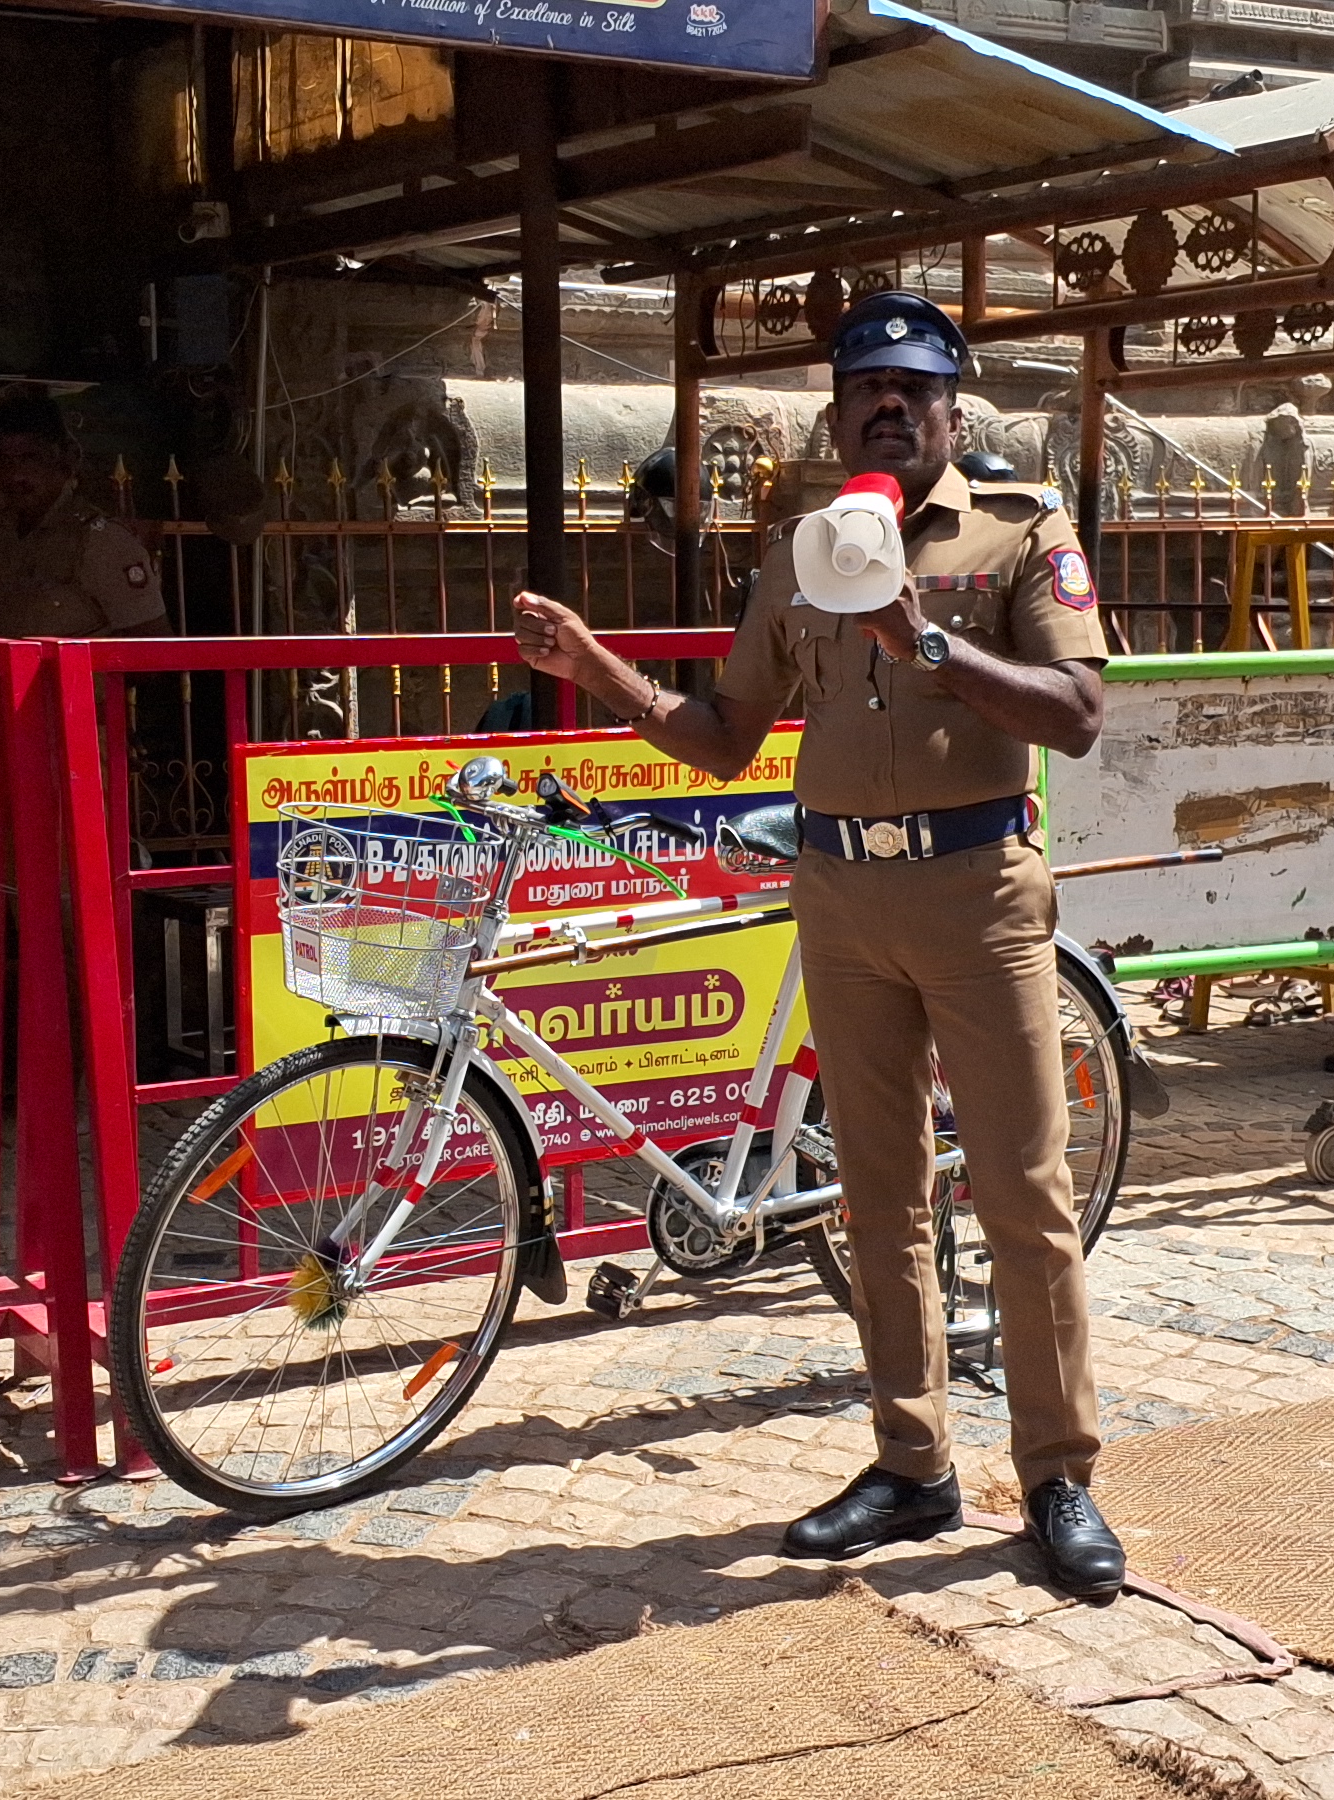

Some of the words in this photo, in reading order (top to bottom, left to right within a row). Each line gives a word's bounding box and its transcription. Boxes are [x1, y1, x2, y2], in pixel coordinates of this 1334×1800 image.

[474, 2, 491, 25] of
[496, 1, 573, 26] Excellence
[580, 13, 595, 28] in
[601, 12, 637, 33] Silk
[261, 766, 402, 816] அருள்மிகு
[527, 880, 605, 907] மதுரை
[638, 1043, 741, 1070] பிளாட்டினம்
[669, 1082, 718, 1108] 625
